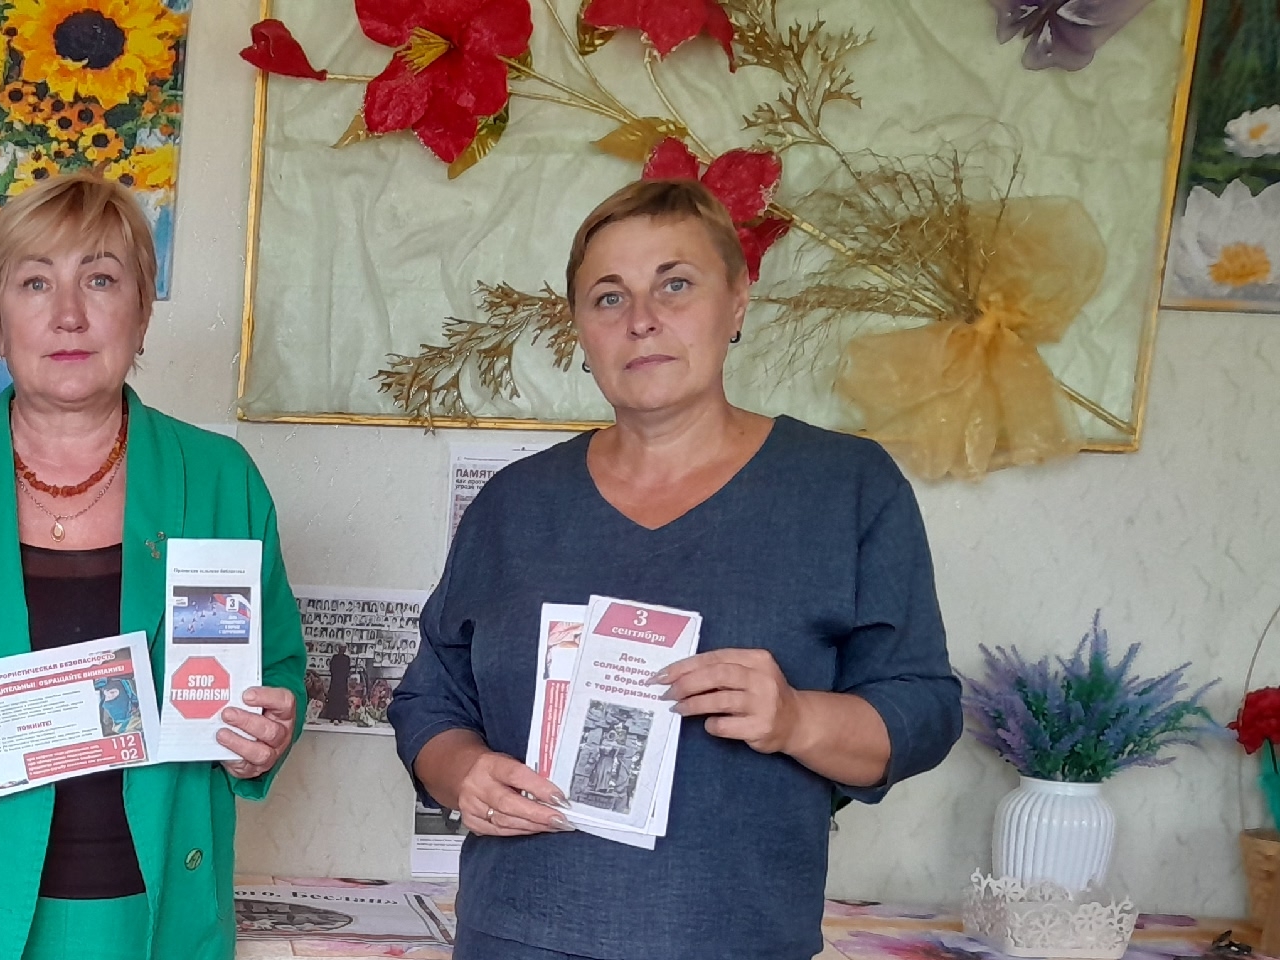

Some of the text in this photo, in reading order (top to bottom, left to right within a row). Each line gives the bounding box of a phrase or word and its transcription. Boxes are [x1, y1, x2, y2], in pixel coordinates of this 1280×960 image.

[229, 598, 236, 608] 3
[633, 609, 649, 627] 3
[611, 626, 666, 643] сентября
[59, 653, 116, 669] БЕЗОПАСНОСТЬ
[618, 652, 647, 664] День
[593, 660, 657, 677] солидарнос
[38, 673, 82, 687] ОБРАЩАЙТЕ
[188, 674, 215, 687] STOP
[171, 688, 231, 701] TERRORISM
[17, 720, 53, 732] ПОМНИТЕ!
[111, 734, 137, 750] 112
[121, 749, 139, 761] 02
